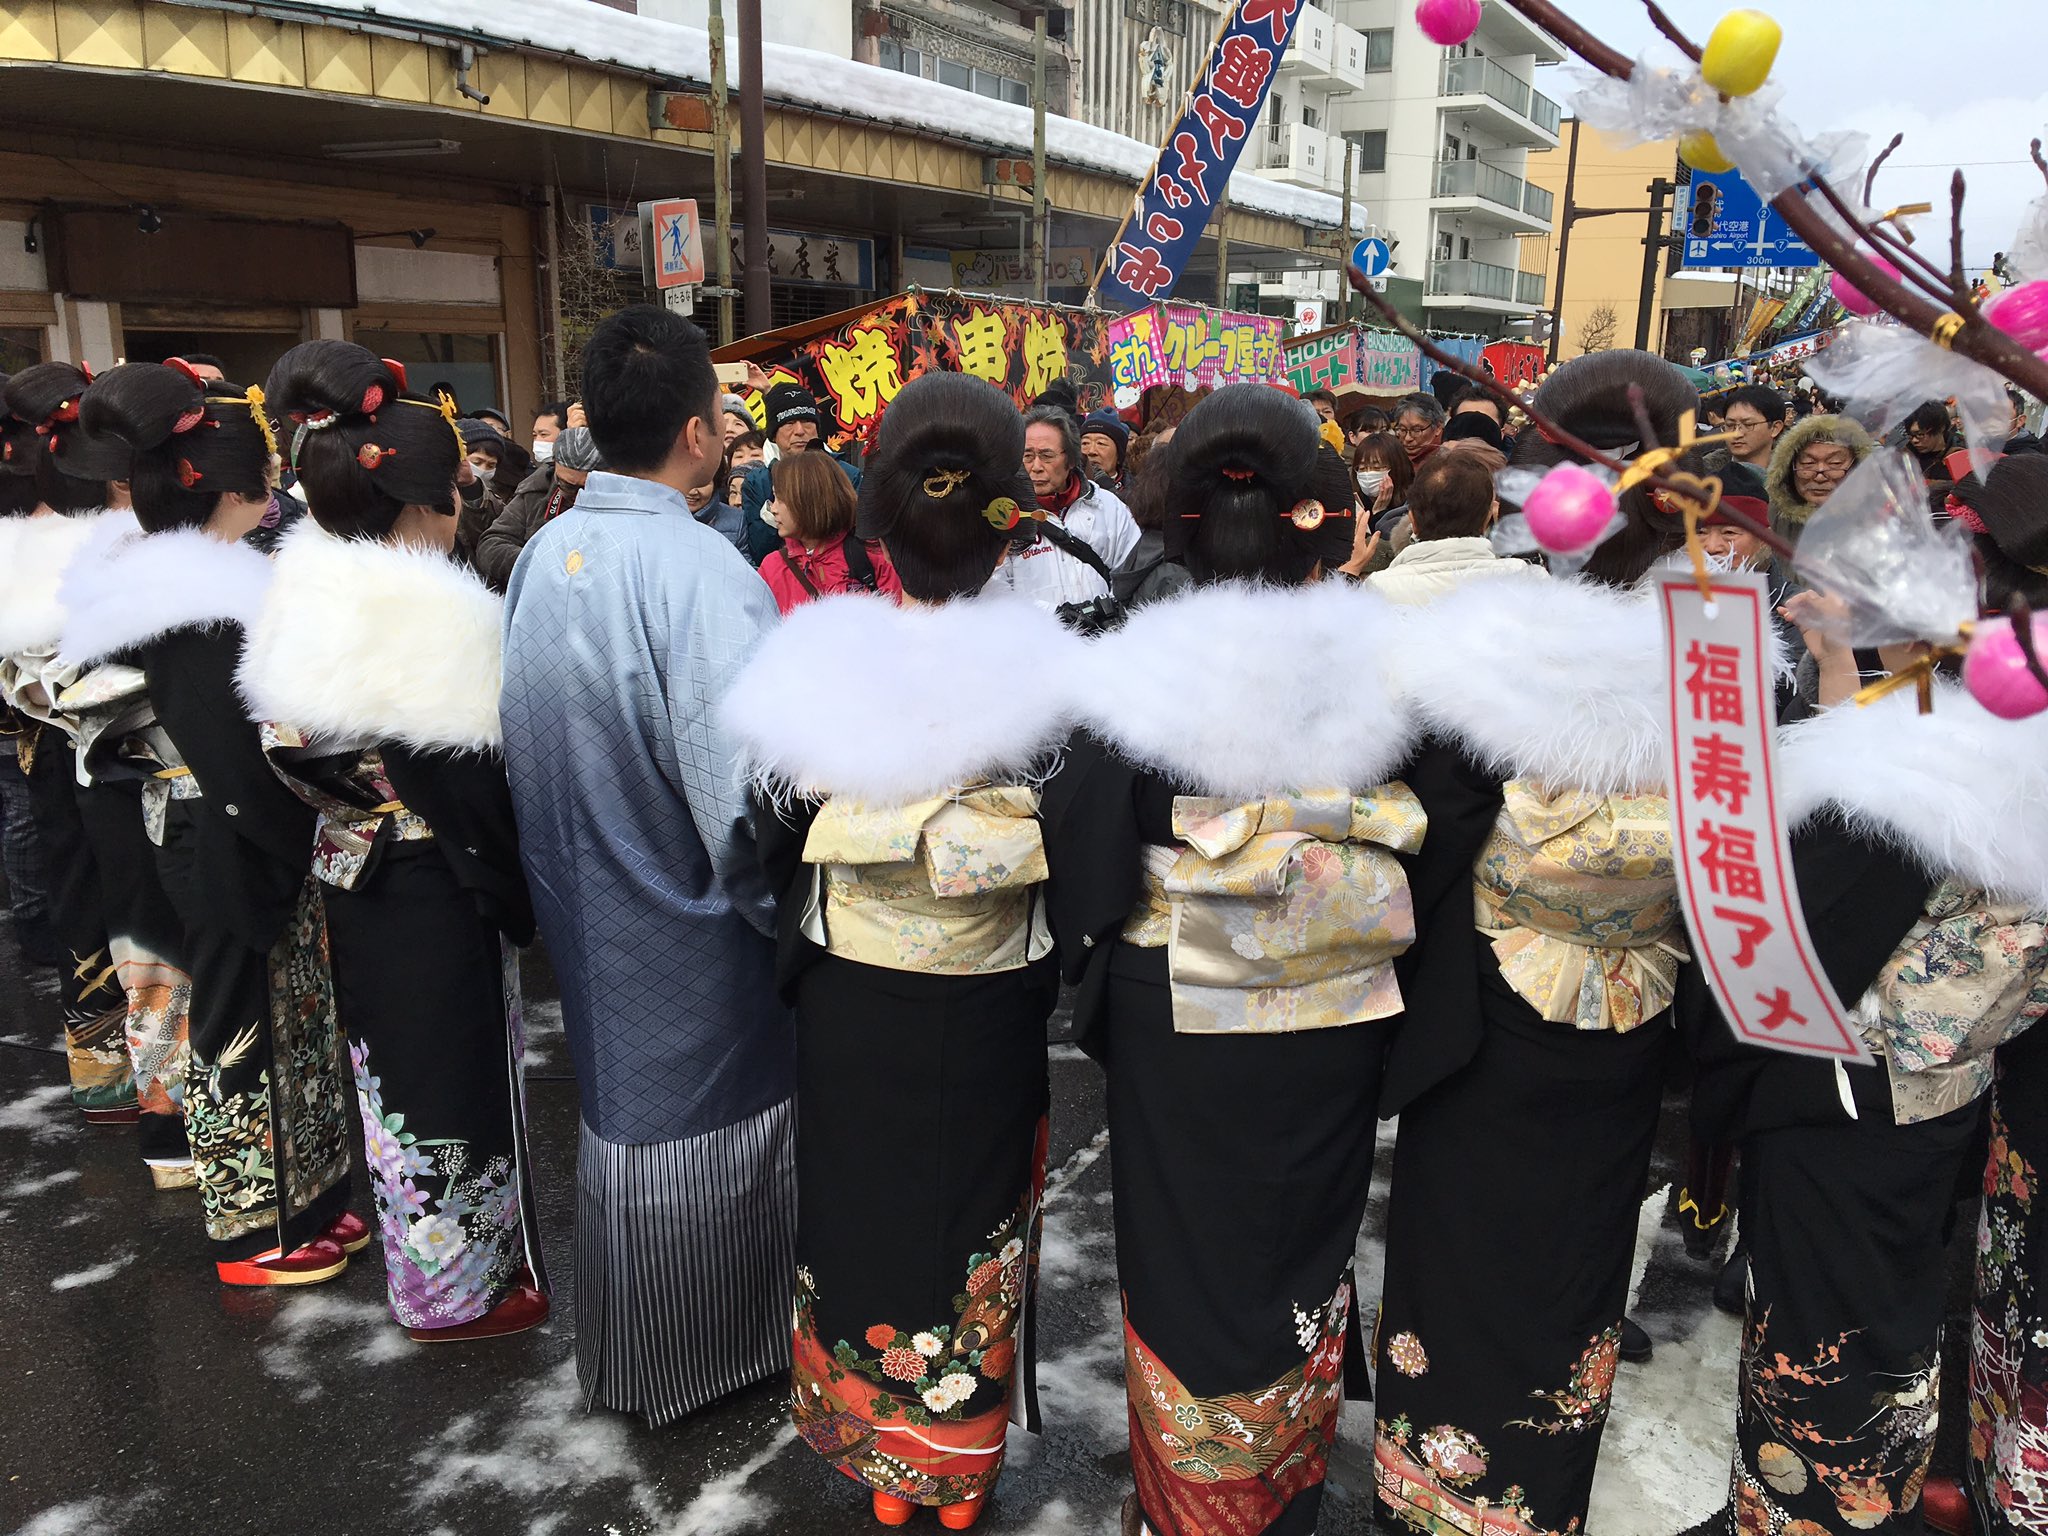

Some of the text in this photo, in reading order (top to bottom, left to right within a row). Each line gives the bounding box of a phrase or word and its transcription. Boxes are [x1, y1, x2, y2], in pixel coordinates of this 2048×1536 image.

[1729, 232, 1749, 240] Airport
[1737, 241, 1743, 249] 7
[1779, 241, 1785, 249] 7
[1747, 256, 1773, 265] 300m
[668, 290, 691, 305] わたるな
[952, 307, 1067, 399] 串焼
[1162, 319, 1281, 377] クレープ屋さん
[1021, 545, 1053, 560] Wilson
[1685, 639, 1809, 1031] 福寿福アメ
